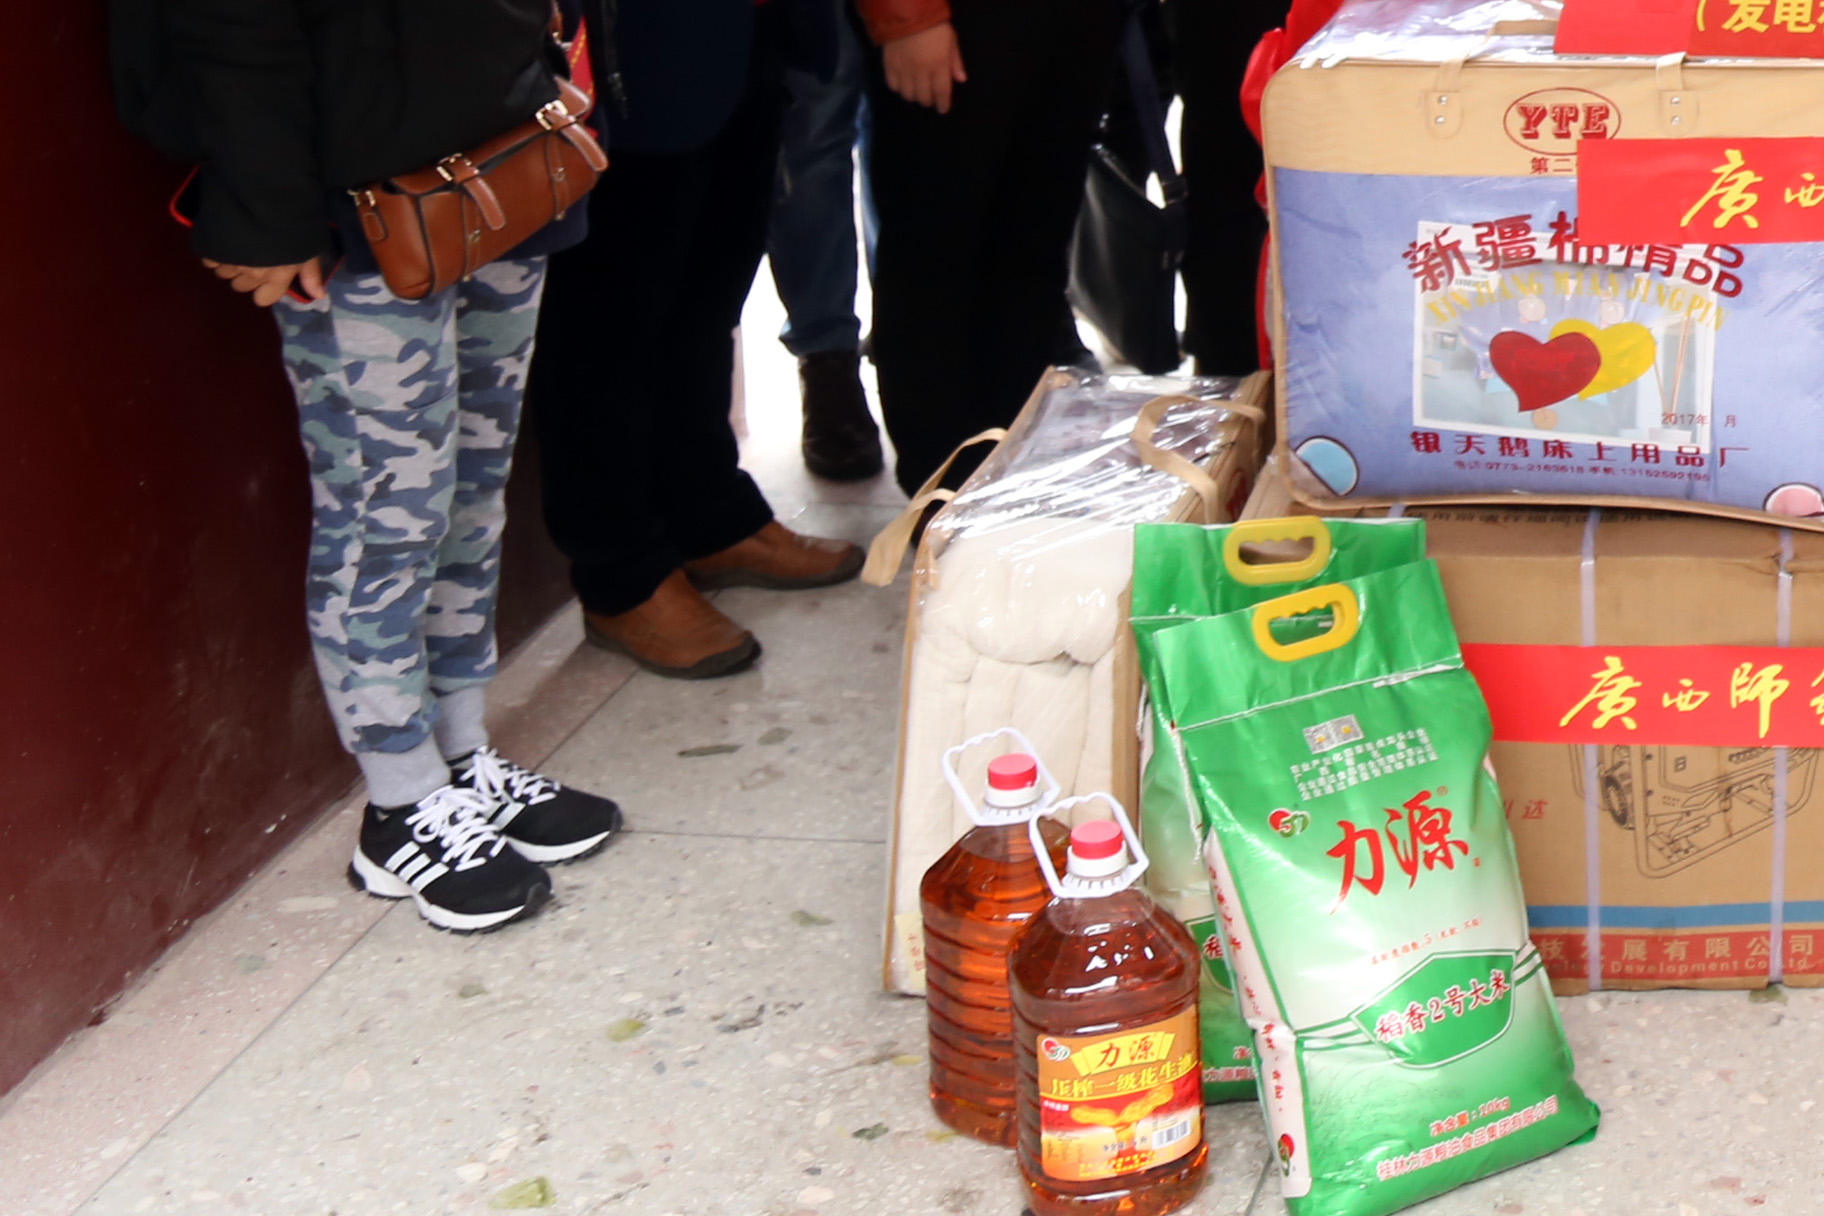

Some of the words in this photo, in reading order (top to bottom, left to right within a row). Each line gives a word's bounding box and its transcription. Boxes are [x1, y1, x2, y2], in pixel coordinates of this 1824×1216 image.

[1516, 102, 1611, 141] YTE
[1530, 156, 1578, 176] 第二
[1409, 430, 1750, 469] 银天鹅床上用品厂
[1326, 790, 1470, 916] 力源
[1375, 970, 1510, 1043] 稻香2号大米
[1096, 1035, 1154, 1069] 力源
